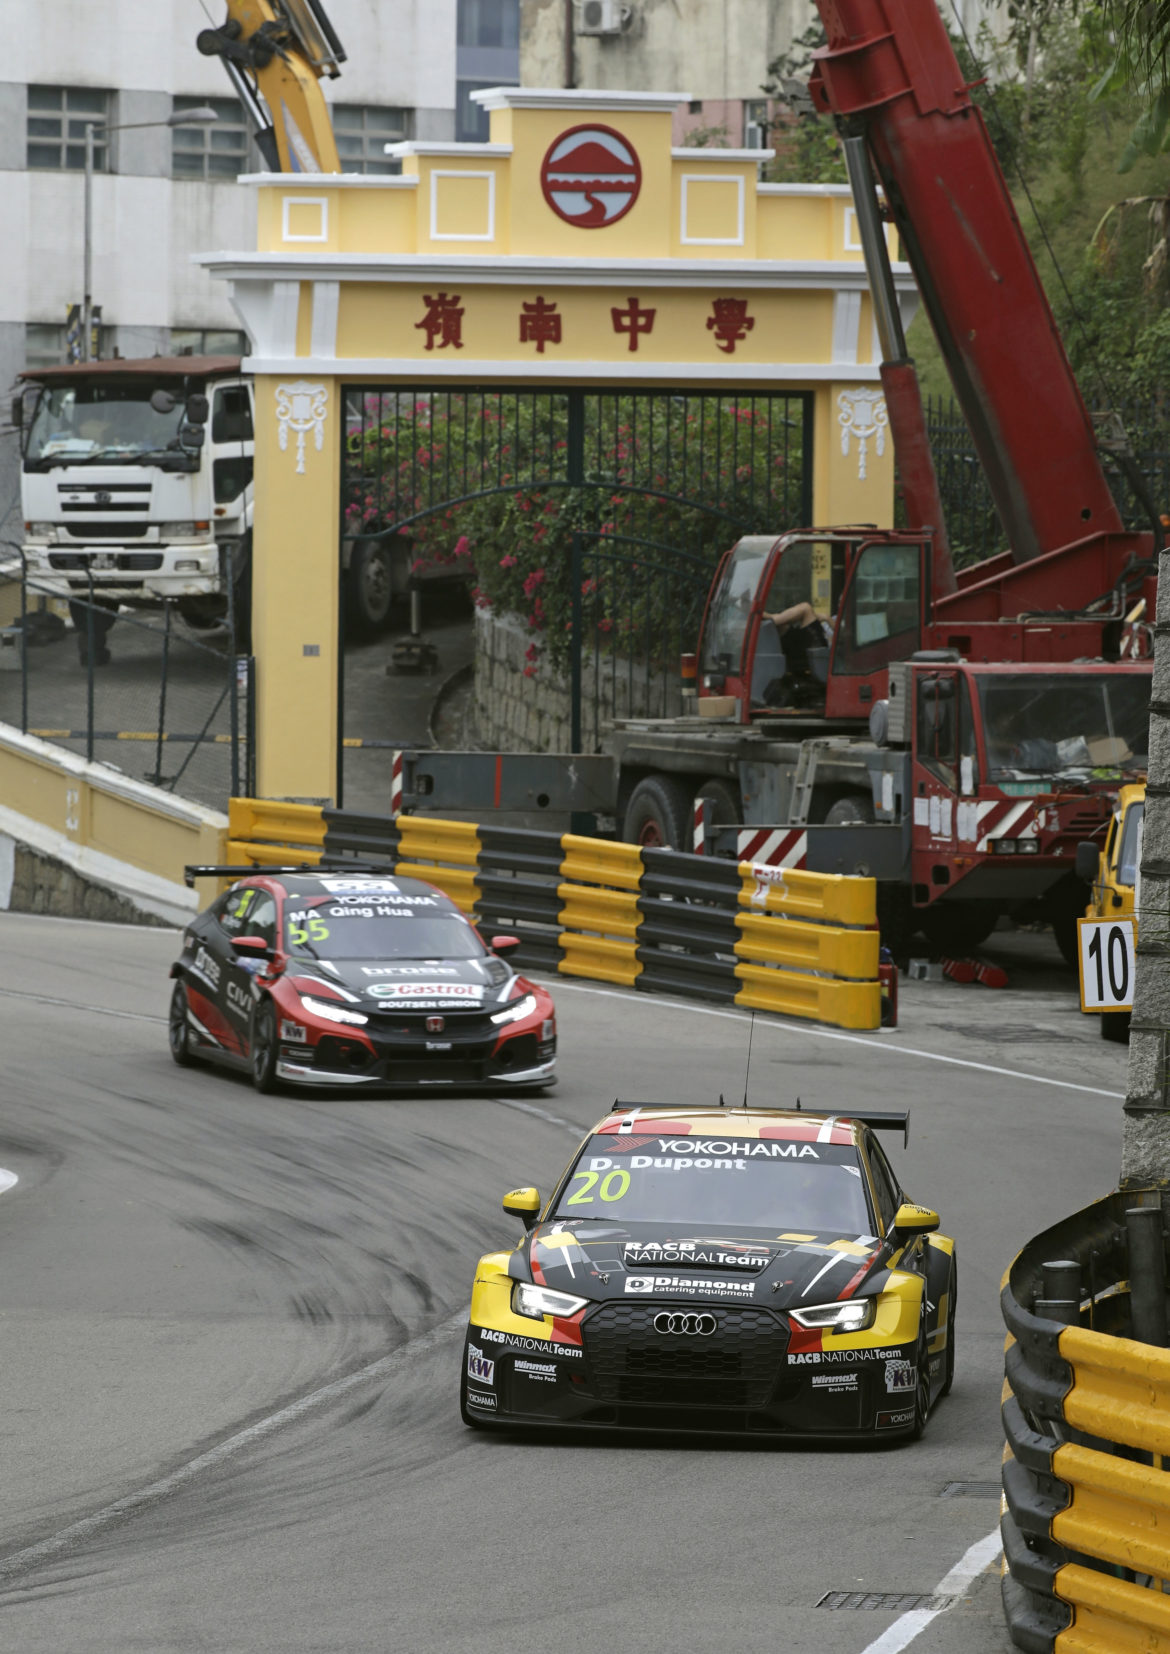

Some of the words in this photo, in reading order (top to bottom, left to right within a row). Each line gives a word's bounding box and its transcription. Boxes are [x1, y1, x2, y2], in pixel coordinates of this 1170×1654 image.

[335, 896, 437, 906] YOKOHAMA
[289, 909, 321, 922] MA
[329, 906, 374, 918] Qing
[377, 906, 414, 917] Hua
[288, 918, 330, 945] 55
[1088, 925, 1129, 1002] 10
[227, 980, 252, 1012] CIVI
[398, 984, 475, 996] Castrol
[378, 1000, 437, 1008] BOUTSEN
[658, 1138, 820, 1159] YOKOHAMA
[589, 1156, 621, 1172] D.
[630, 1155, 747, 1171] Dupont
[566, 1169, 631, 1206] 20
[625, 1242, 697, 1251] RACB
[654, 1286, 695, 1295] catering
[698, 1288, 753, 1298] equipment
[655, 1277, 755, 1292] Diamond
[529, 1373, 543, 1381] Brake
